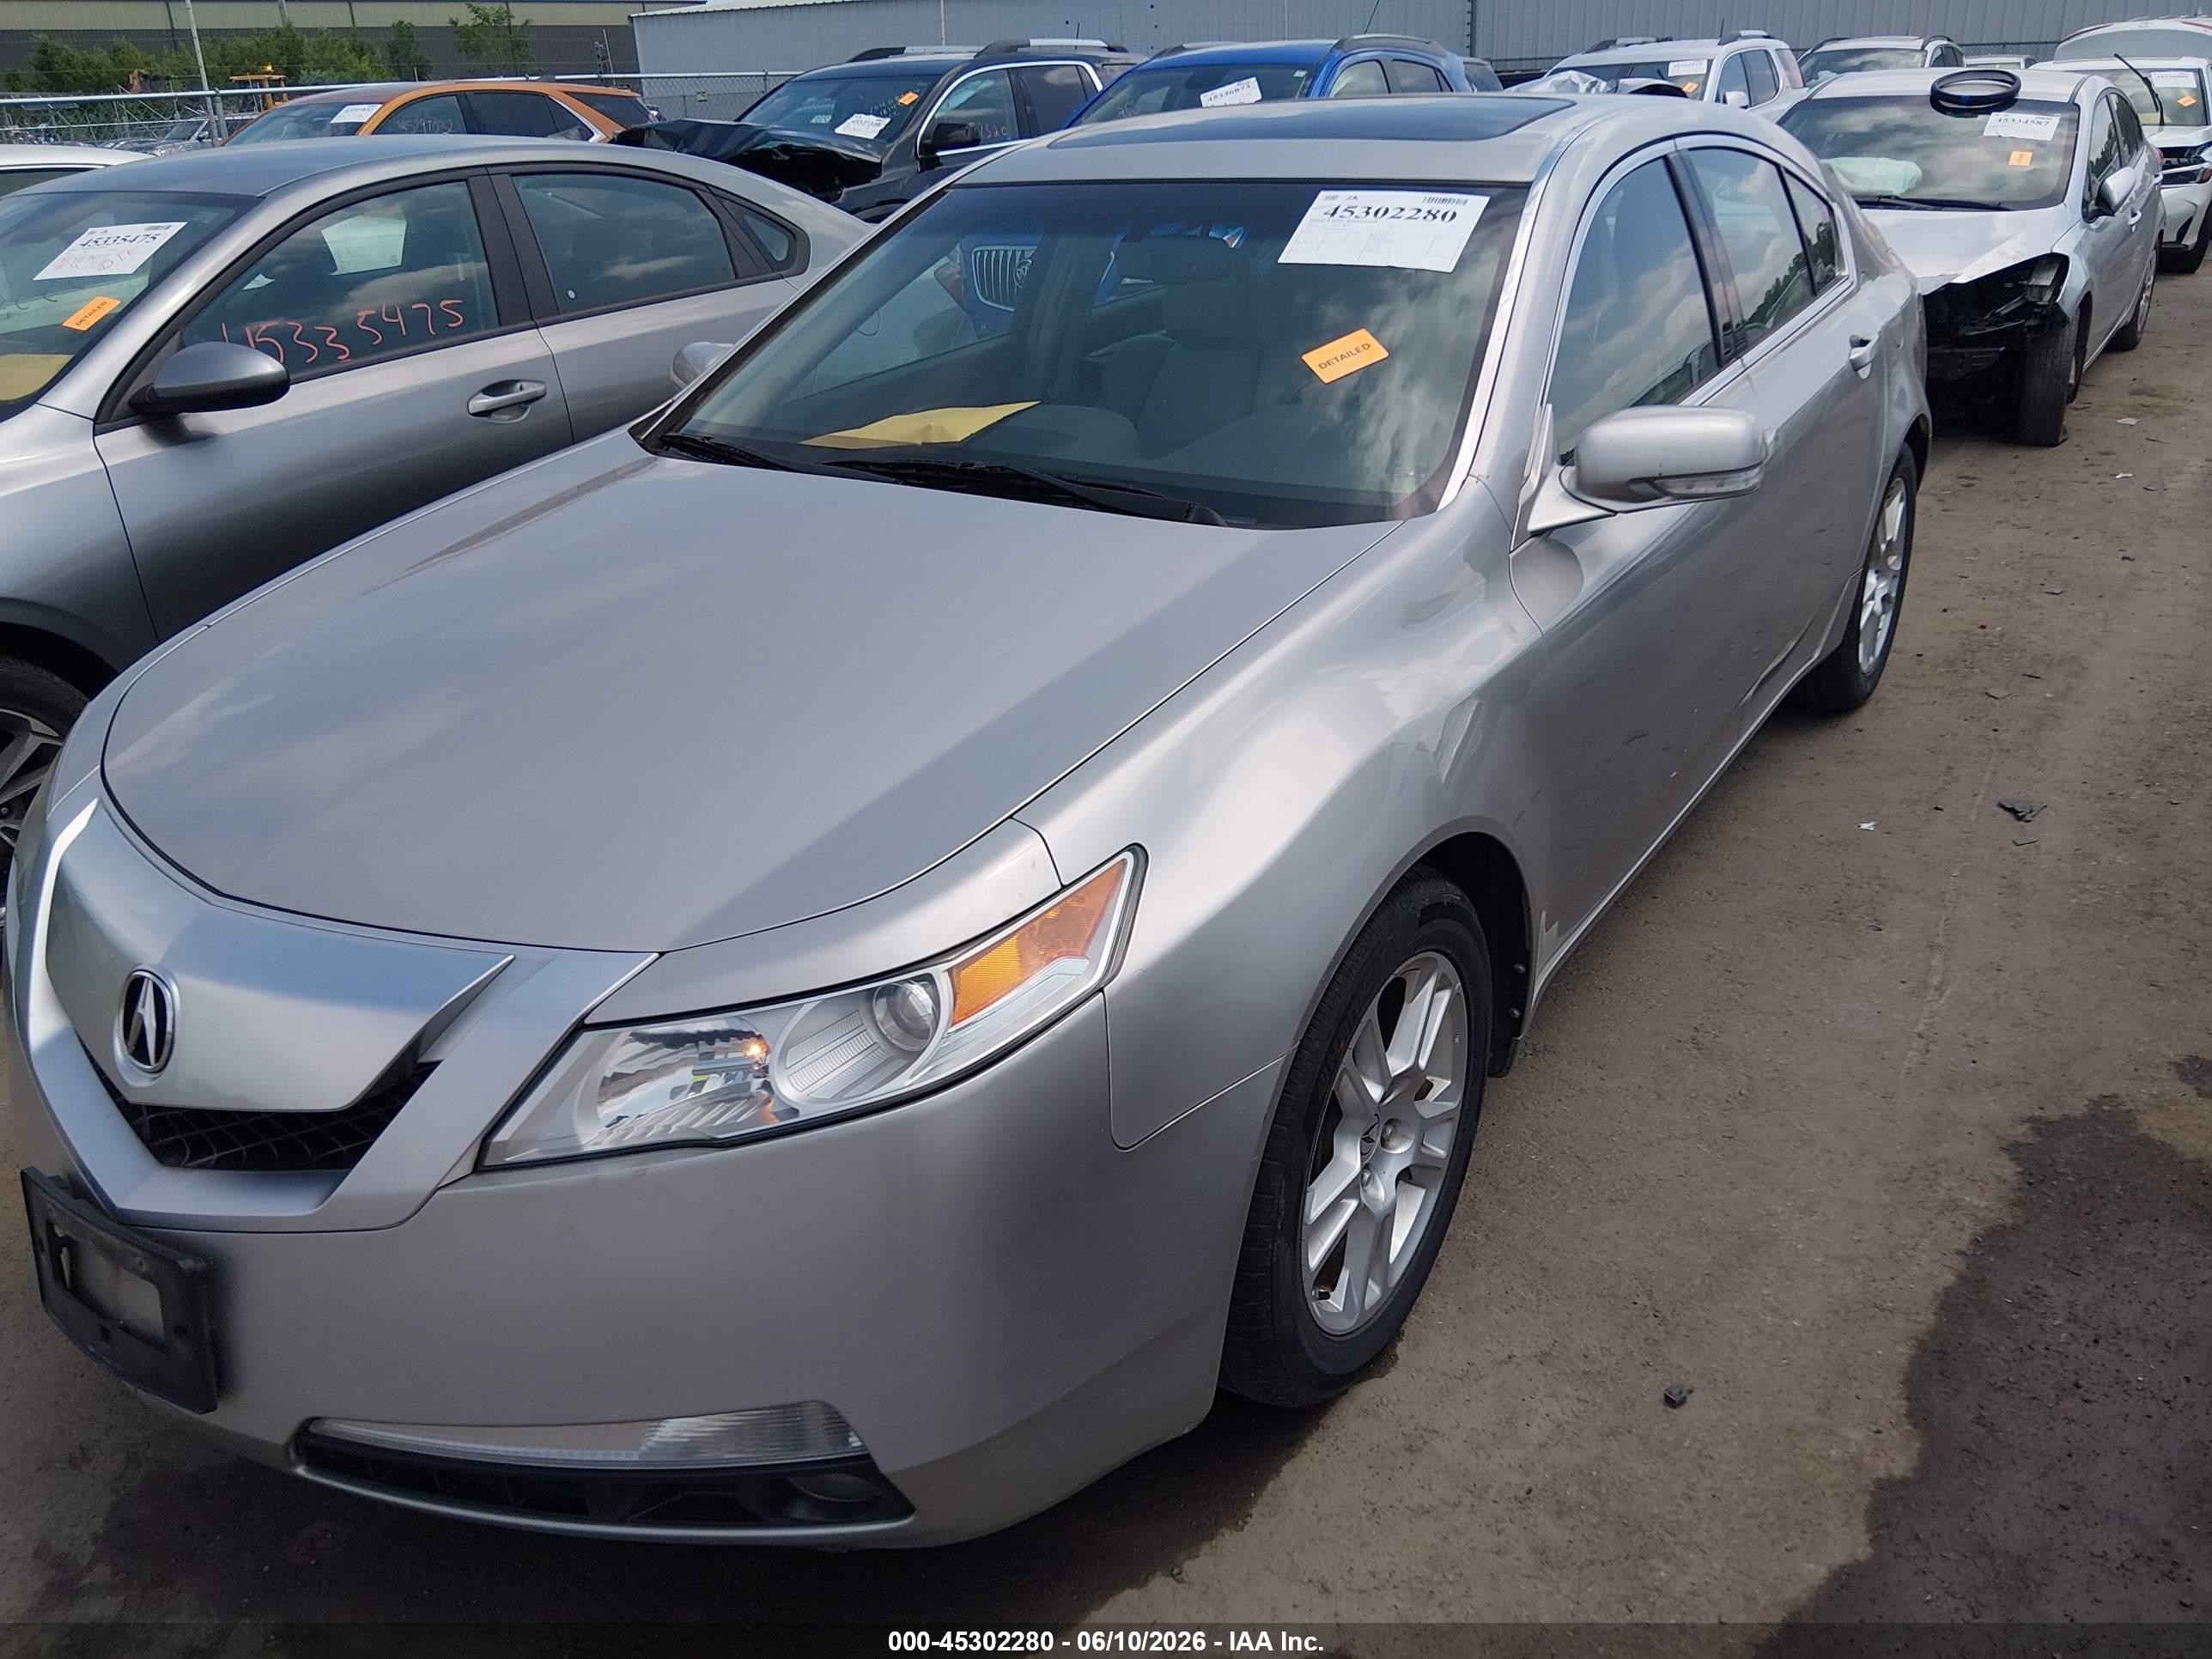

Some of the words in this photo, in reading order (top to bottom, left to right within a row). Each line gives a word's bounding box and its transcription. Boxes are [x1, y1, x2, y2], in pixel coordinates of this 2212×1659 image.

[1323, 204, 1458, 223] 45302280
[79, 233, 161, 248] 45335475
[76, 301, 107, 326] DETAILED
[1318, 343, 1371, 369] DETAILED
